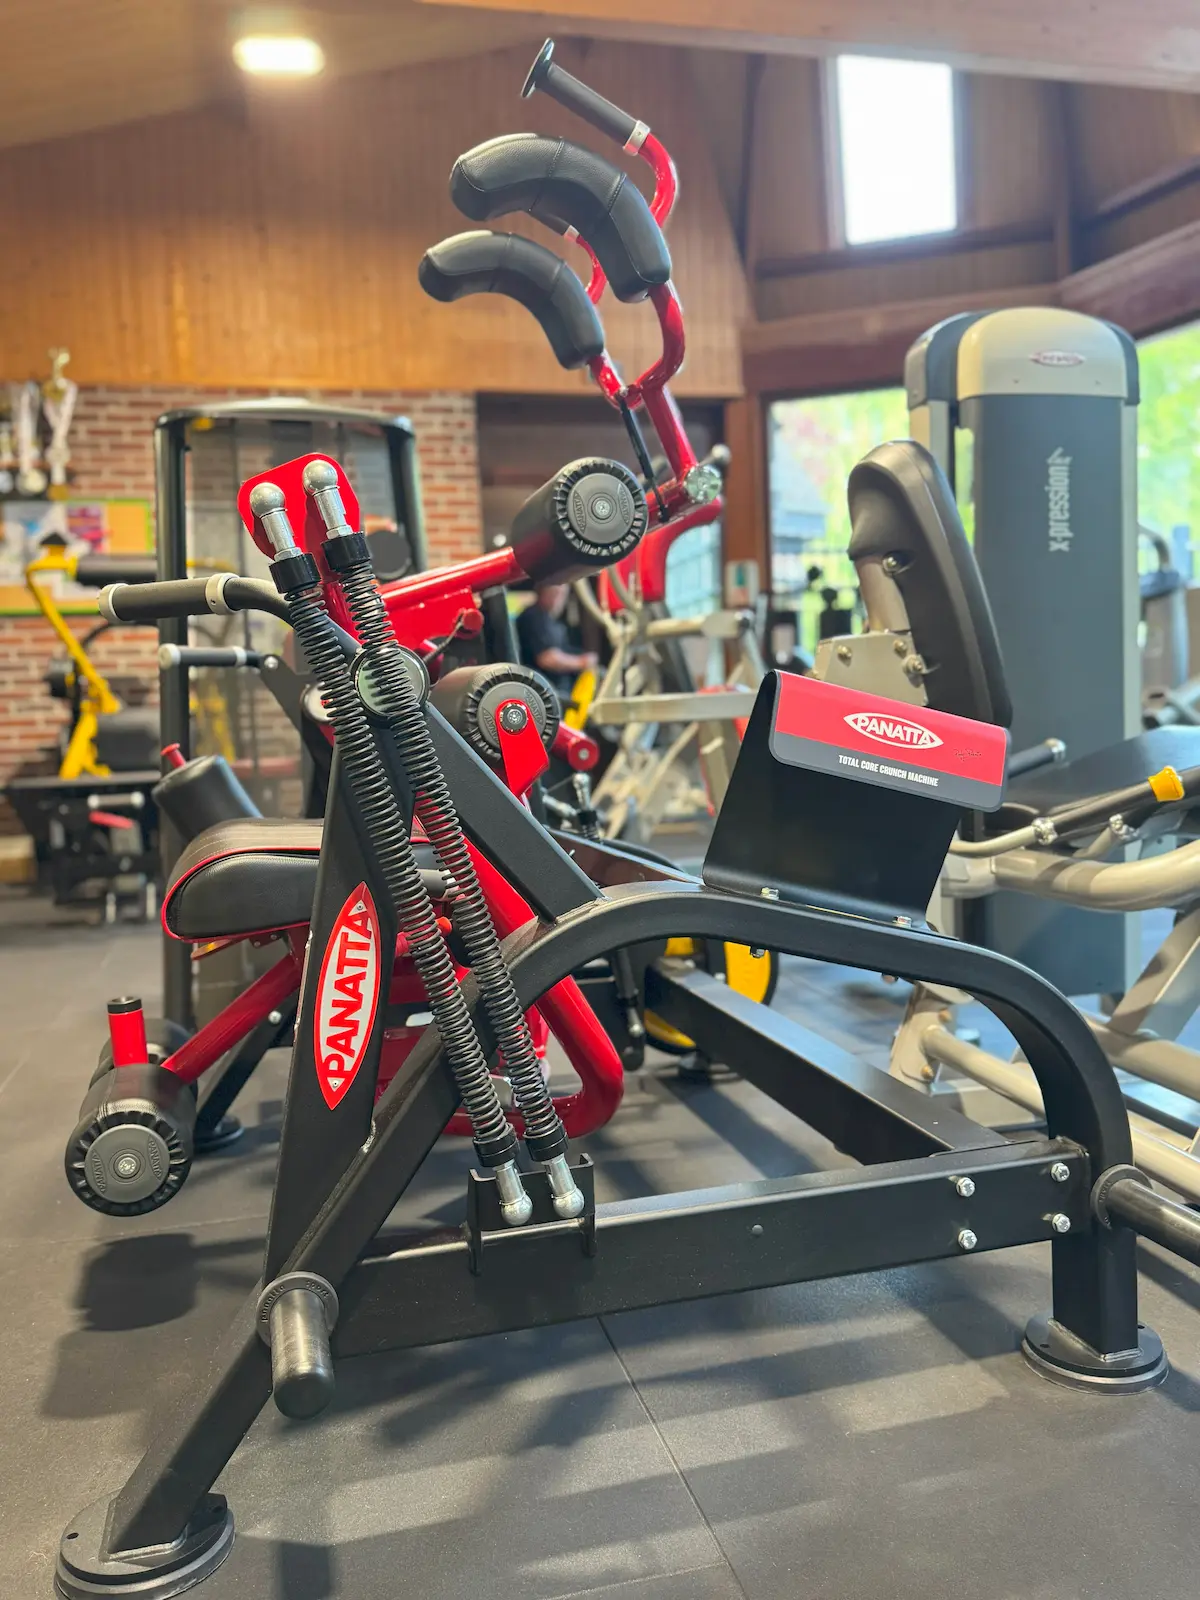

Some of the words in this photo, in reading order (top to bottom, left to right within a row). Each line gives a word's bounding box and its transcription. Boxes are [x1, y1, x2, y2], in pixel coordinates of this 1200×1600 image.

[856, 714, 934, 746] PANATTA
[838, 754, 860, 768] TOTAL
[860, 760, 879, 773] CORE
[879, 764, 907, 779] CRUNCH
[907, 771, 939, 787] MACHINE
[323, 908, 373, 1078] PANATTA
